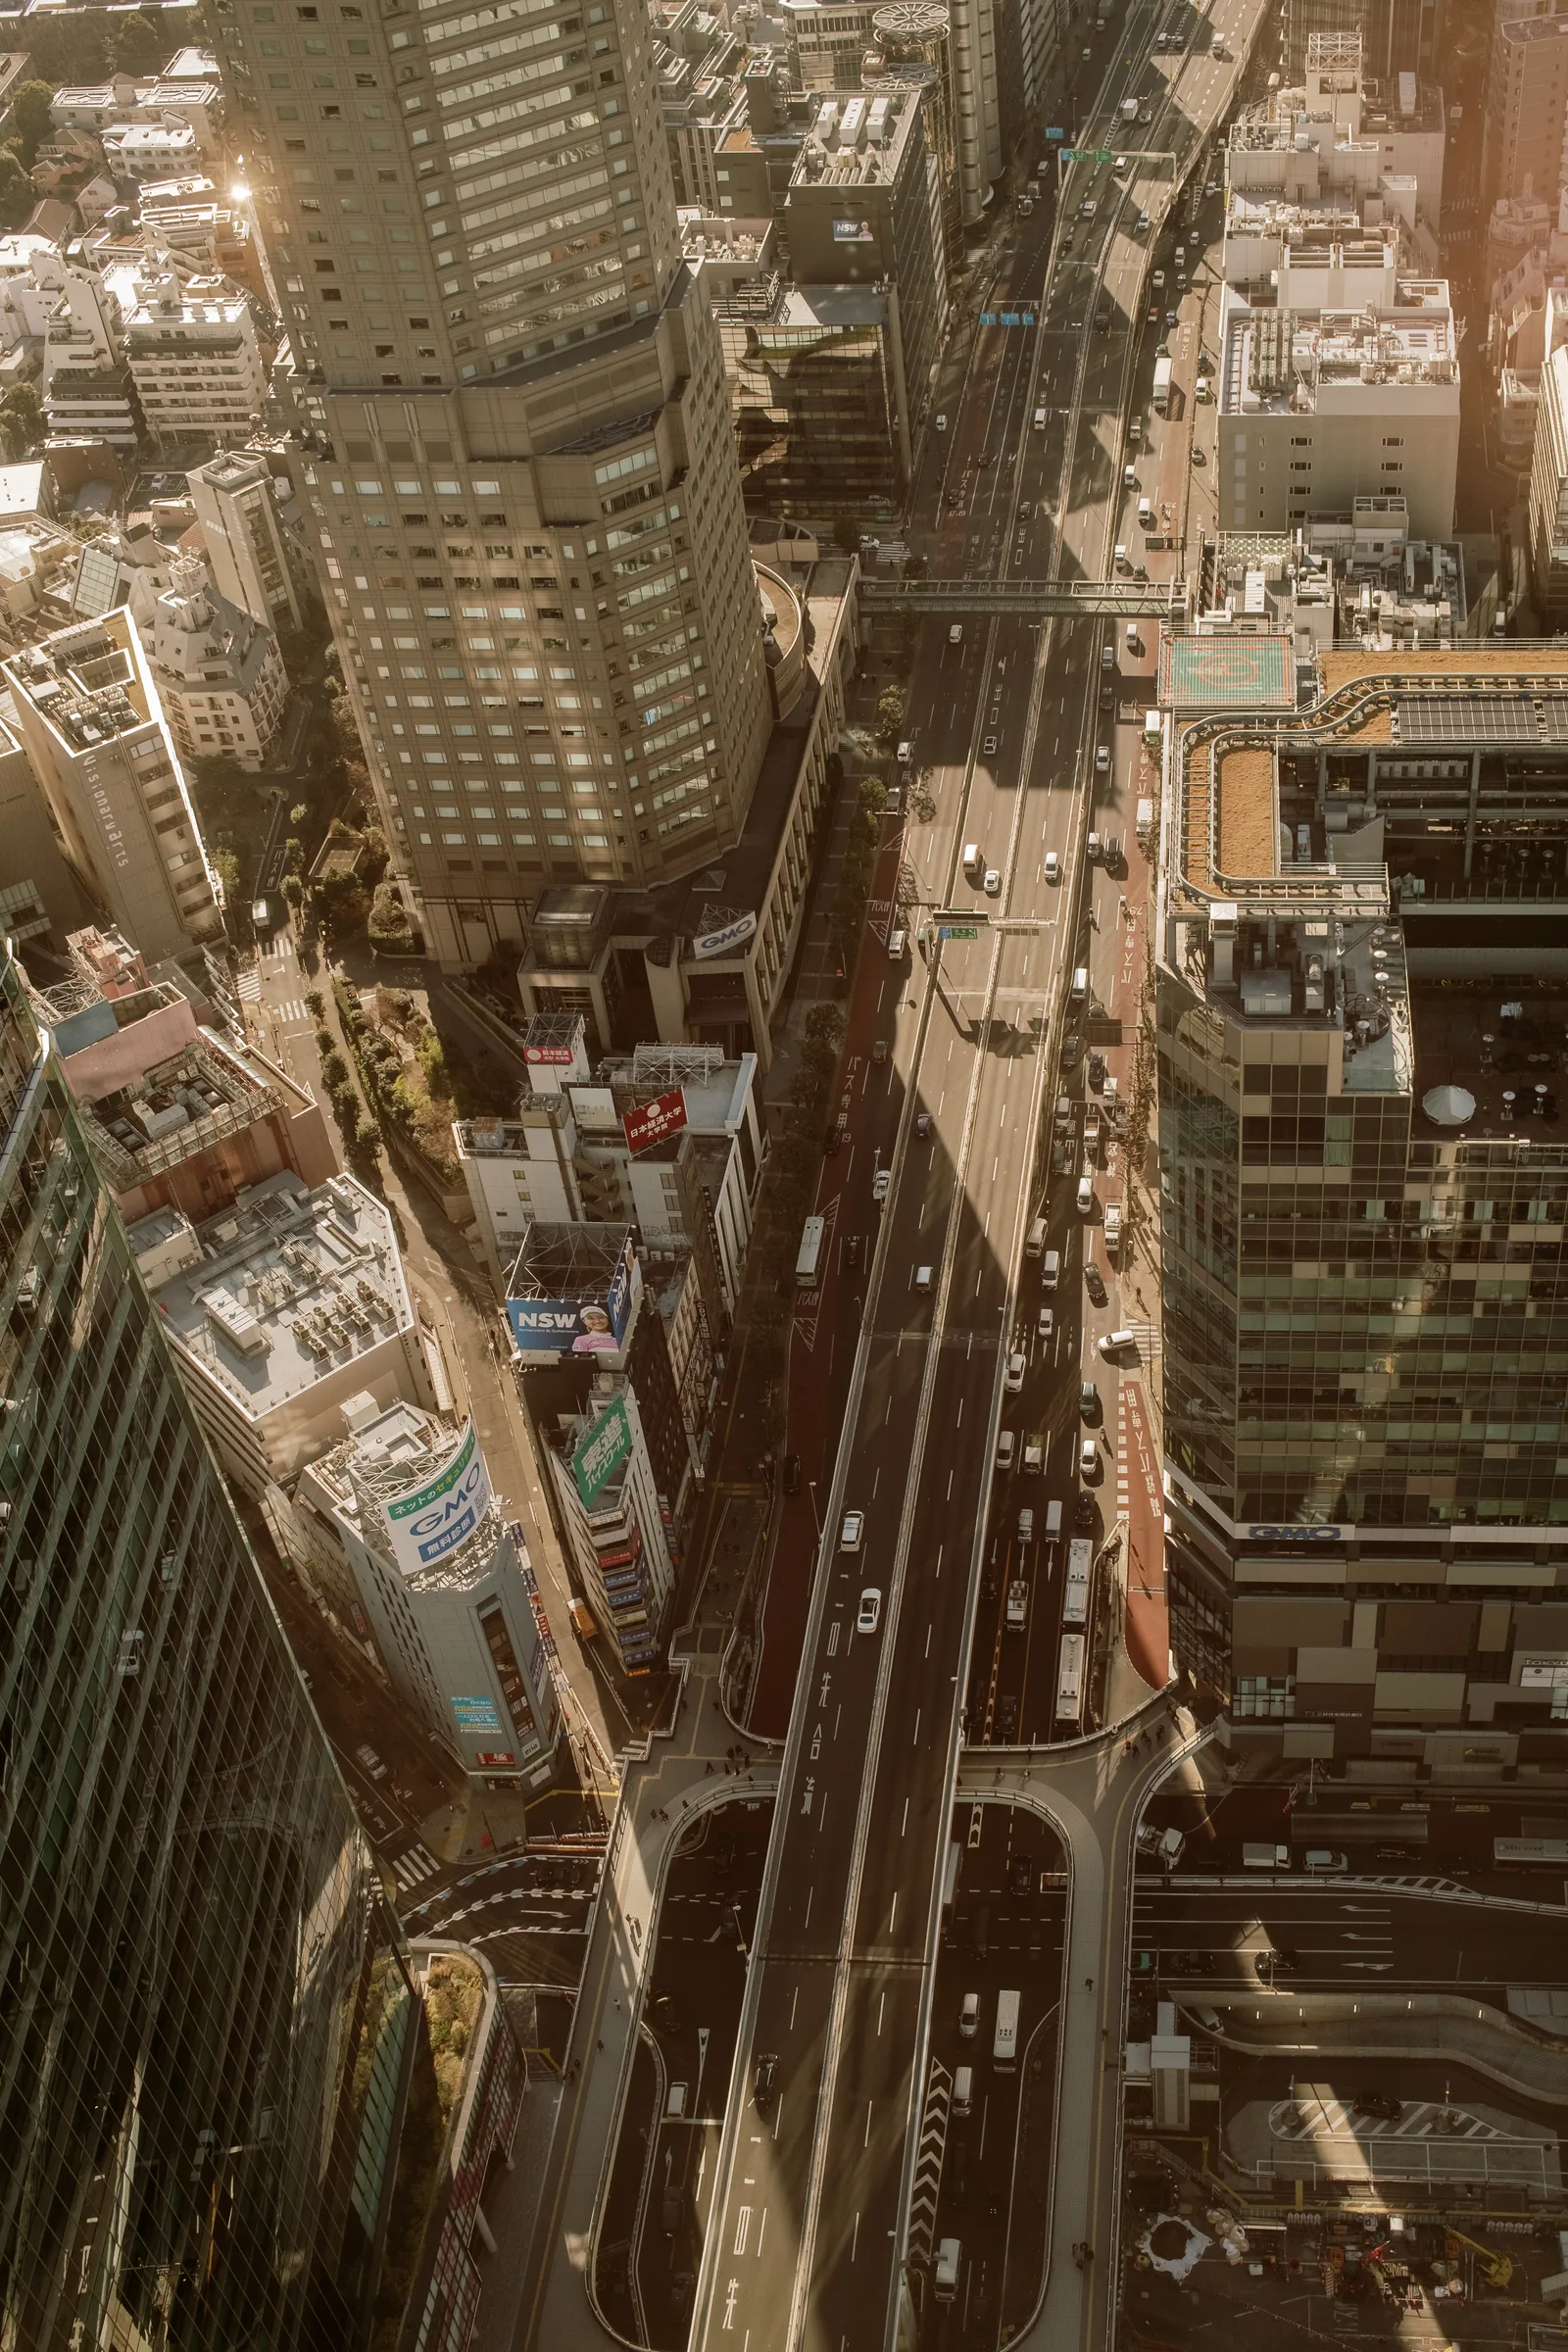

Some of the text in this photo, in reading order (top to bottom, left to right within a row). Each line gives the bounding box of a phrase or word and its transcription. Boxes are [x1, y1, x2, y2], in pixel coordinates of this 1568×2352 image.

[837, 223, 858, 232] NSW
[1014, 527, 1027, 564] 出口
[990, 684, 1003, 724] 出口
[702, 920, 753, 949] GMO
[837, 1055, 861, 1128] バス専用
[630, 1105, 682, 1139] 日本経済大学
[646, 1124, 668, 1138] 大学院
[612, 1265, 627, 1322] NSW
[518, 1312, 576, 1328] NSW
[581, 1412, 623, 1481] 東進
[587, 1435, 625, 1494] ハイスクール
[410, 1461, 480, 1537] GMO
[426, 1515, 472, 1556] 無料診断
[1250, 1526, 1341, 1540] GMO
[524, 1742, 538, 1756] ena
